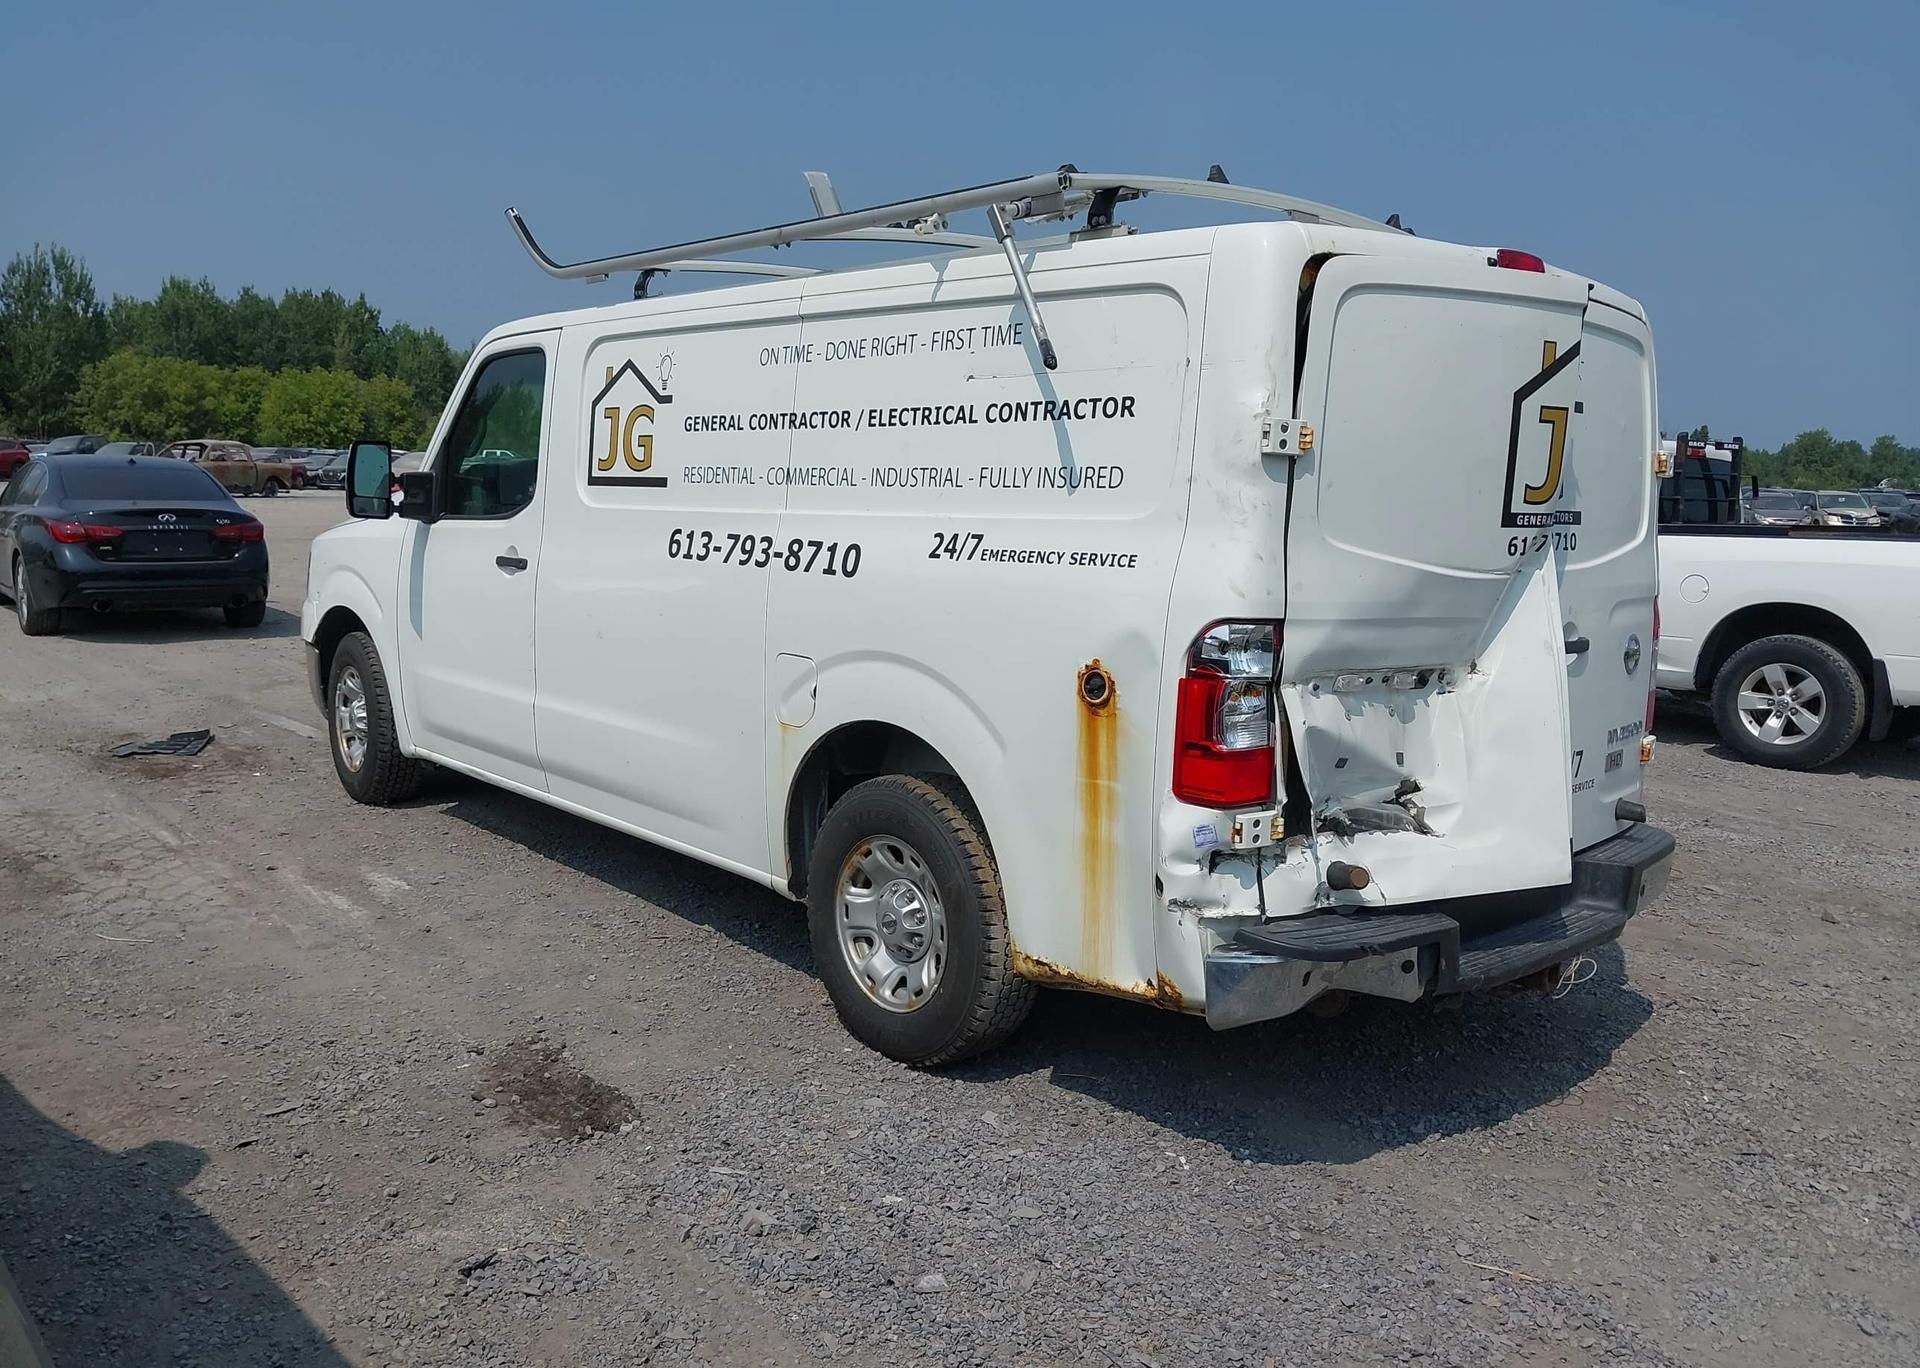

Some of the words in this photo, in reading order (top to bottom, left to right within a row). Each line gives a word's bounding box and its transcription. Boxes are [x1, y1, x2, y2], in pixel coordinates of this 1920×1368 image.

[759, 346, 780, 366] ON
[783, 343, 814, 365] TIME
[825, 338, 868, 361] DONE
[870, 332, 919, 357] RIGHT
[931, 327, 977, 352] FIRST
[981, 322, 1024, 348] TIME
[683, 413, 745, 433] GENERAL
[748, 409, 852, 431] CONTRACTOR
[867, 403, 979, 428] ELECTRICAL
[985, 395, 1137, 424] CONTRACTOR
[598, 404, 655, 472] JG
[1523, 405, 1569, 505] J
[683, 465, 756, 485] RESIDENTIAL
[767, 466, 858, 487] COMMERCIAL
[870, 466, 964, 489] INDUSTRIAL
[979, 466, 1034, 489] FULLY
[1037, 465, 1125, 490] INSURED
[667, 528, 863, 579] 613-793-8710
[928, 531, 985, 561] 24/7
[980, 548, 1067, 565] EMERGENCY
[1068, 551, 1139, 569] SERVICE
[1571, 778, 1596, 794] SERVICE
